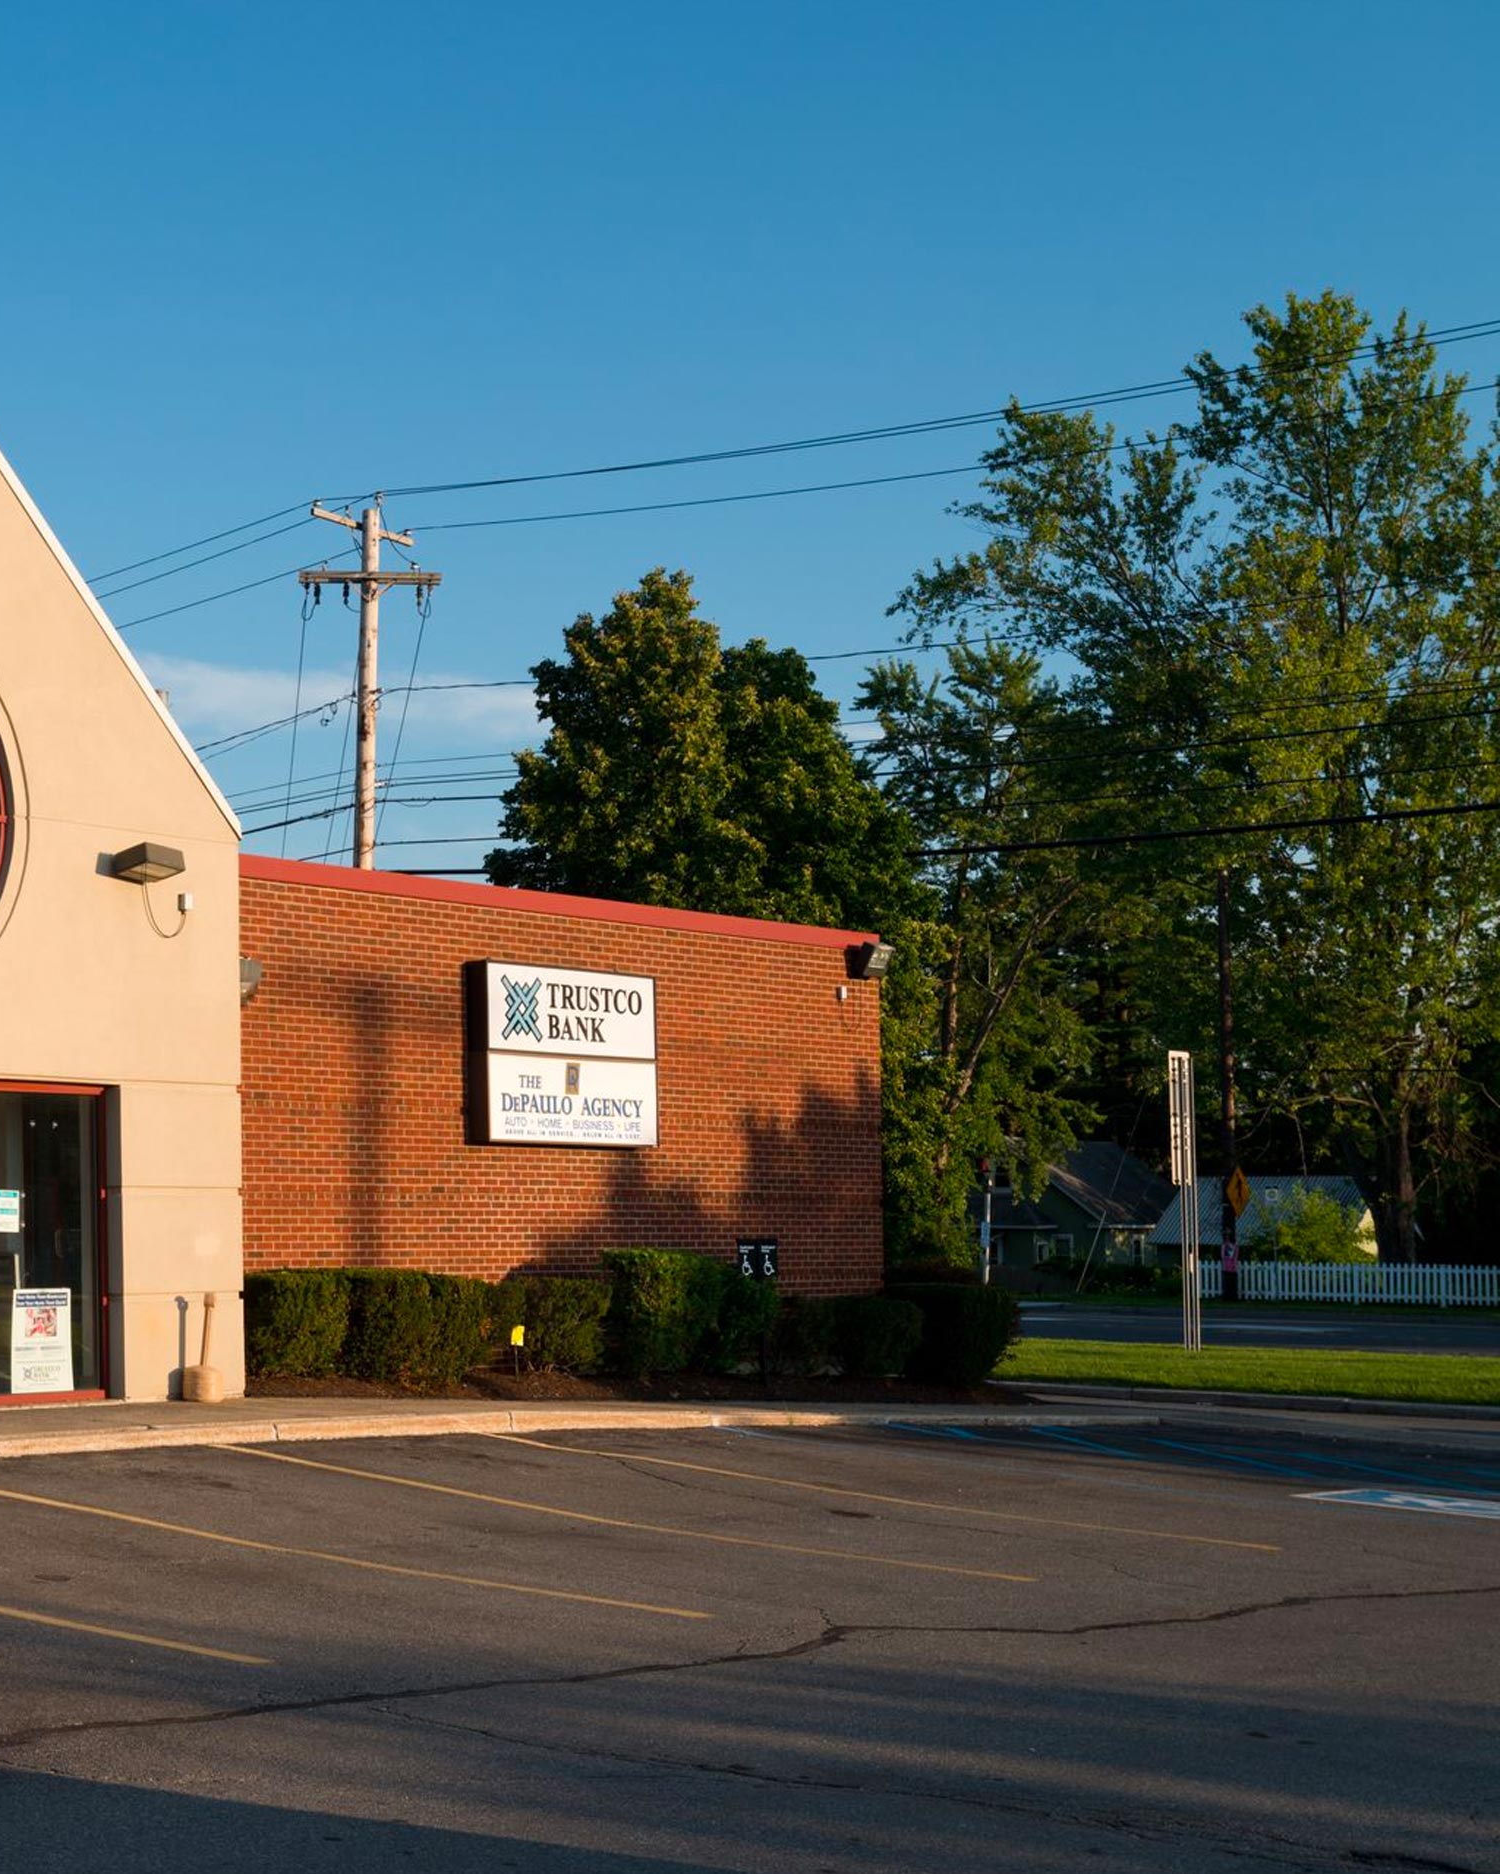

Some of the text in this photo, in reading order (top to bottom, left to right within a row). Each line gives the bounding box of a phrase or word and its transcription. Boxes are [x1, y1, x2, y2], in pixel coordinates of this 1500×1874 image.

[546, 983, 642, 1015] TRUSTCO
[548, 1014, 606, 1043] BANK
[518, 1075, 542, 1089] THE
[581, 1099, 643, 1118] AGENCY
[505, 1116, 641, 1132] AUTO HOME BUSINESS LIFE
